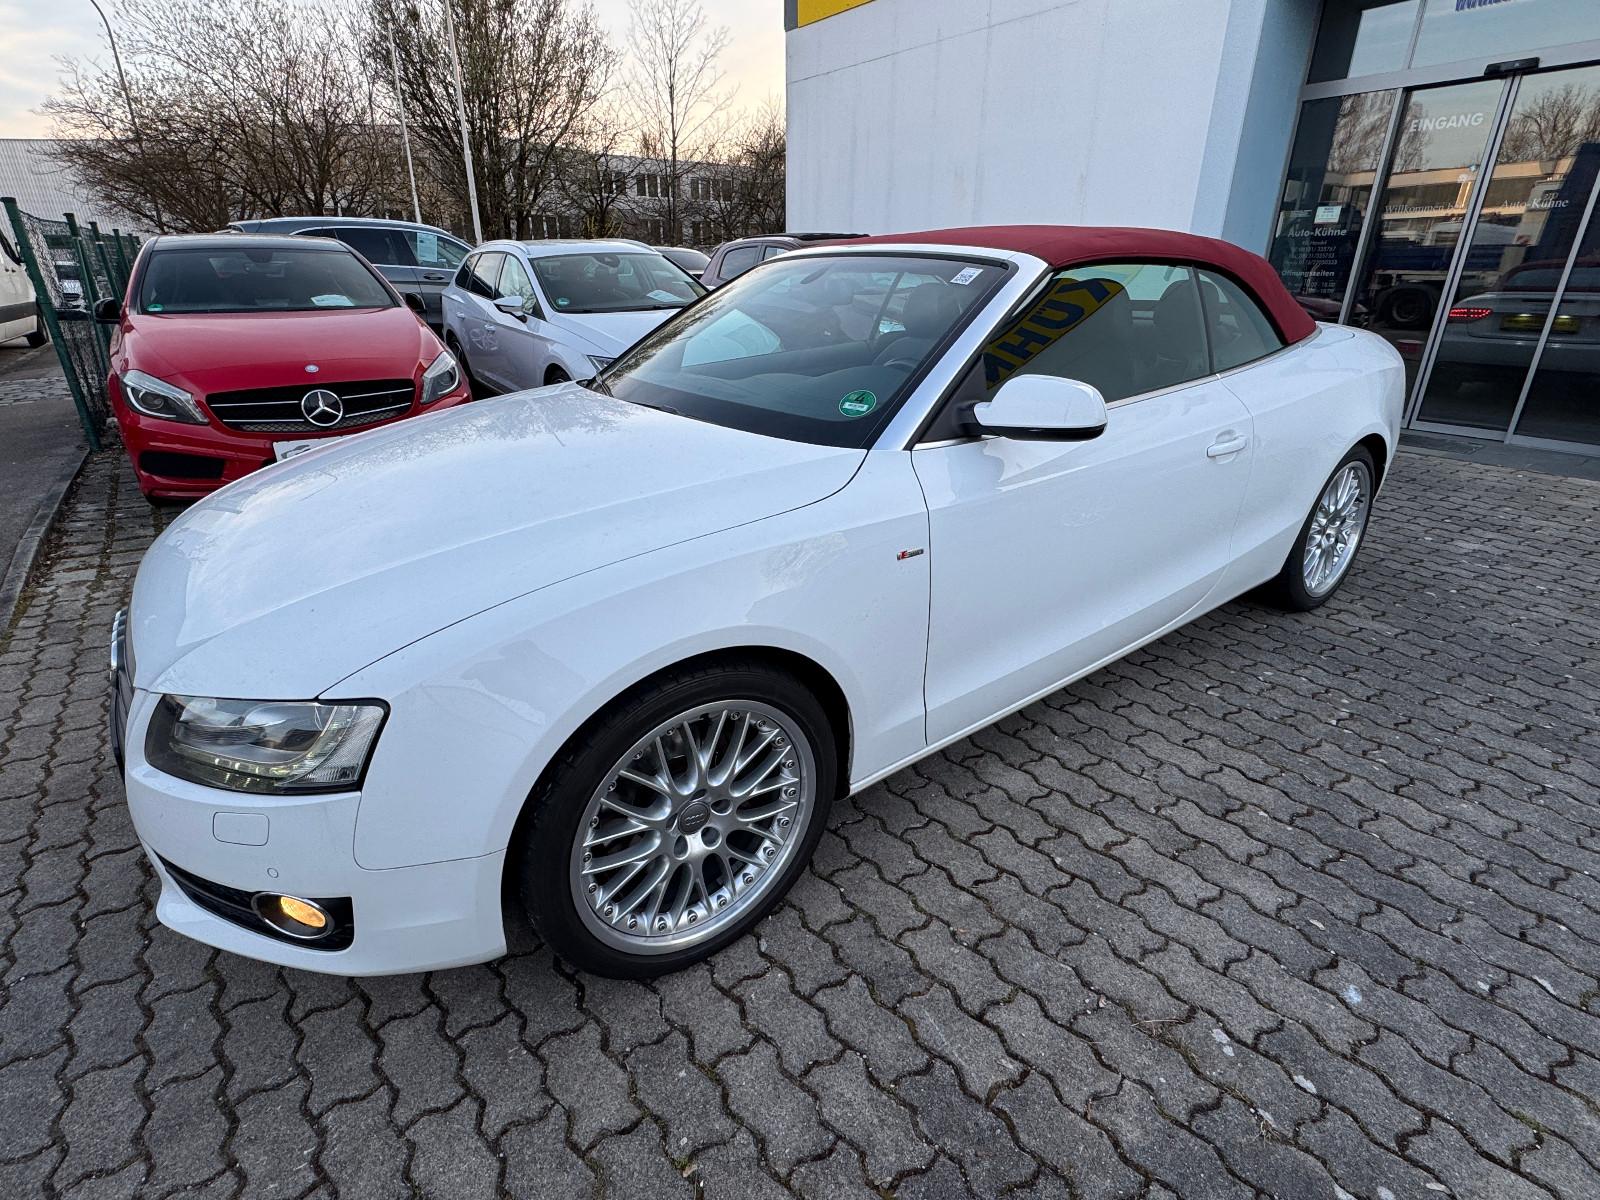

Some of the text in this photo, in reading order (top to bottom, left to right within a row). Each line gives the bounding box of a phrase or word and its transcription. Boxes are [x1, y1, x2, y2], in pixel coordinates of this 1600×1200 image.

[1409, 112, 1484, 132] EINGANG
[1385, 203, 1446, 214] Willkommen
[1502, 198, 1569, 208] Auto-Kühne
[1287, 227, 1347, 237] Auto-Kühne
[854, 392, 866, 404] 4
